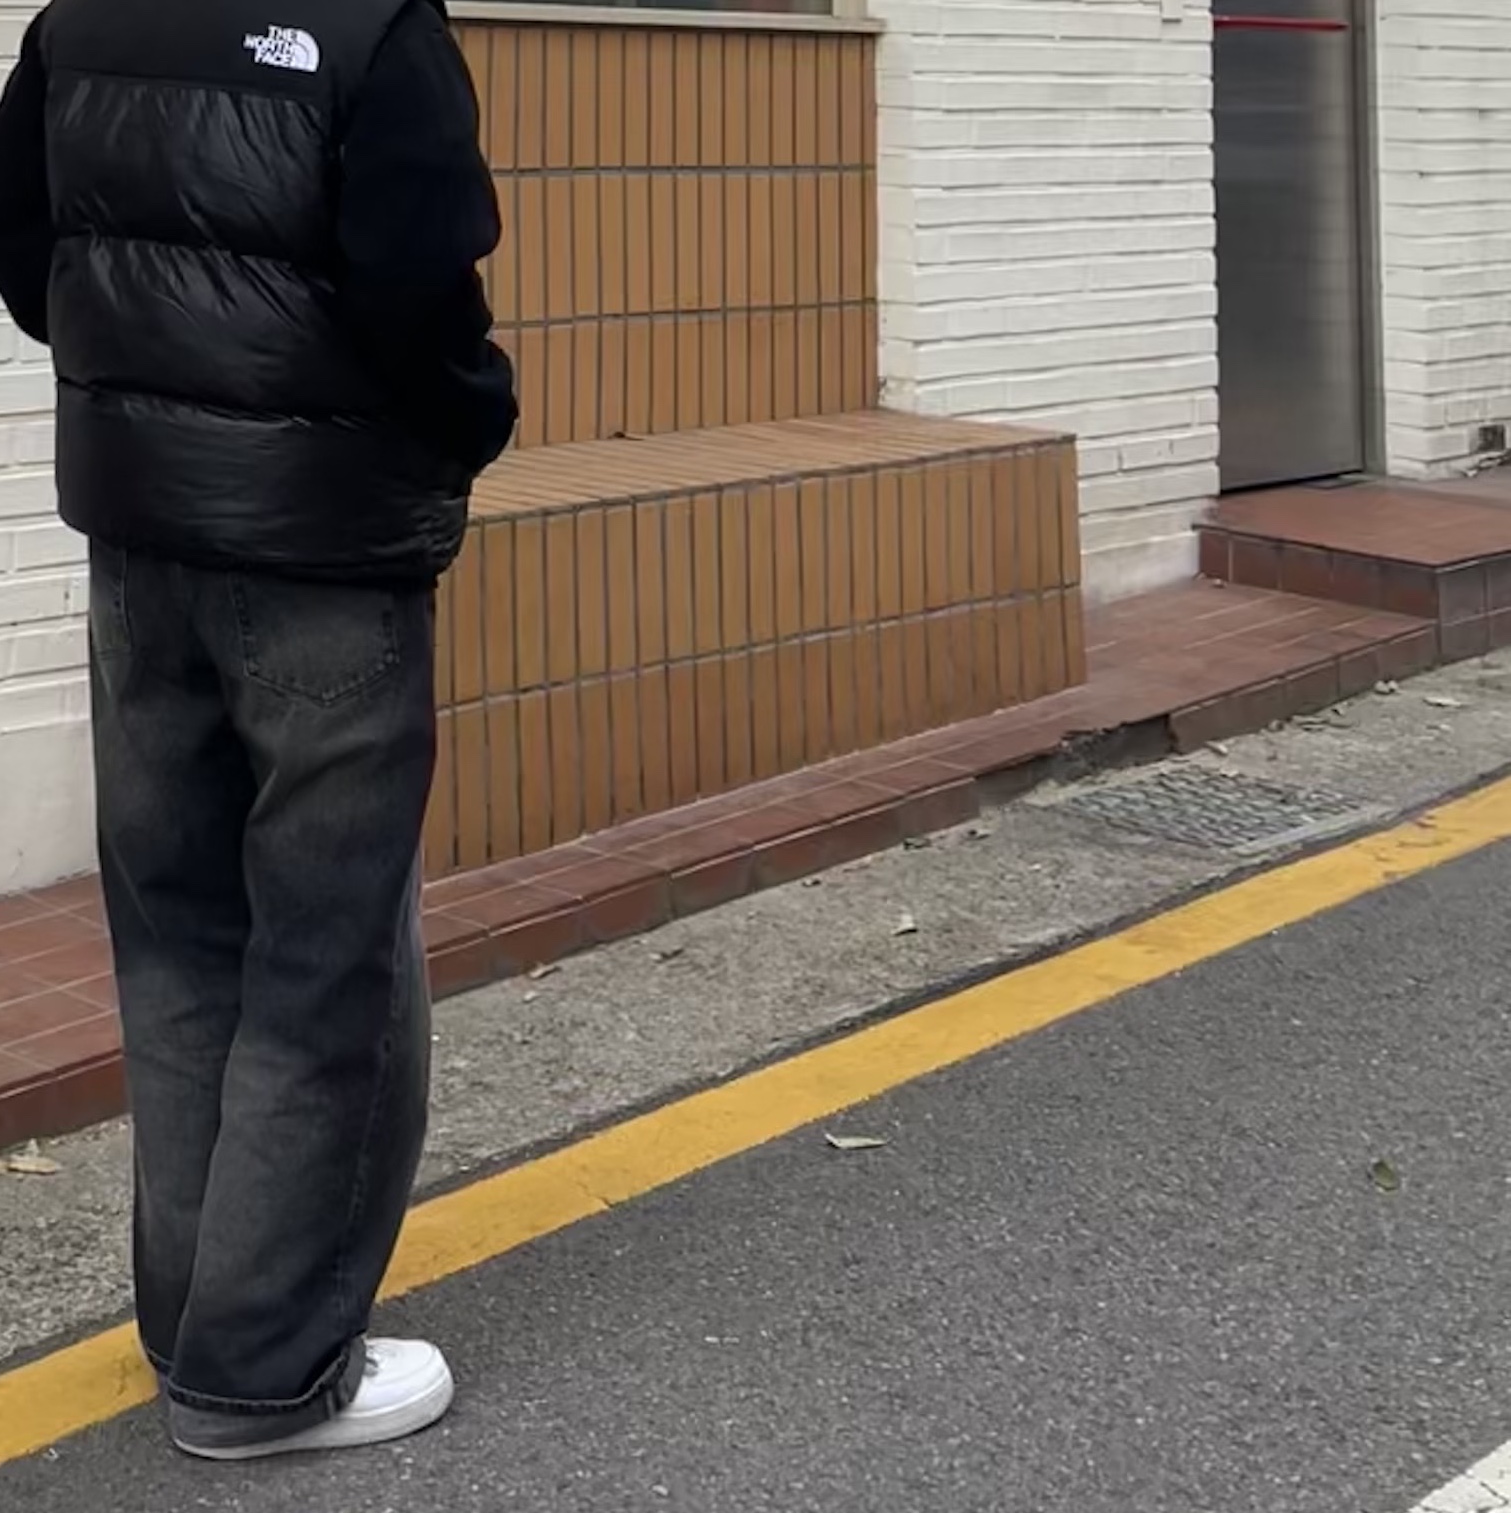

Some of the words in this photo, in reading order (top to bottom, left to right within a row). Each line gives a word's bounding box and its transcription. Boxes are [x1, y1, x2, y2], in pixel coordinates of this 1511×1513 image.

[268, 24, 297, 42] THE
[243, 32, 295, 57] NORTH
[254, 47, 292, 68] FACE
